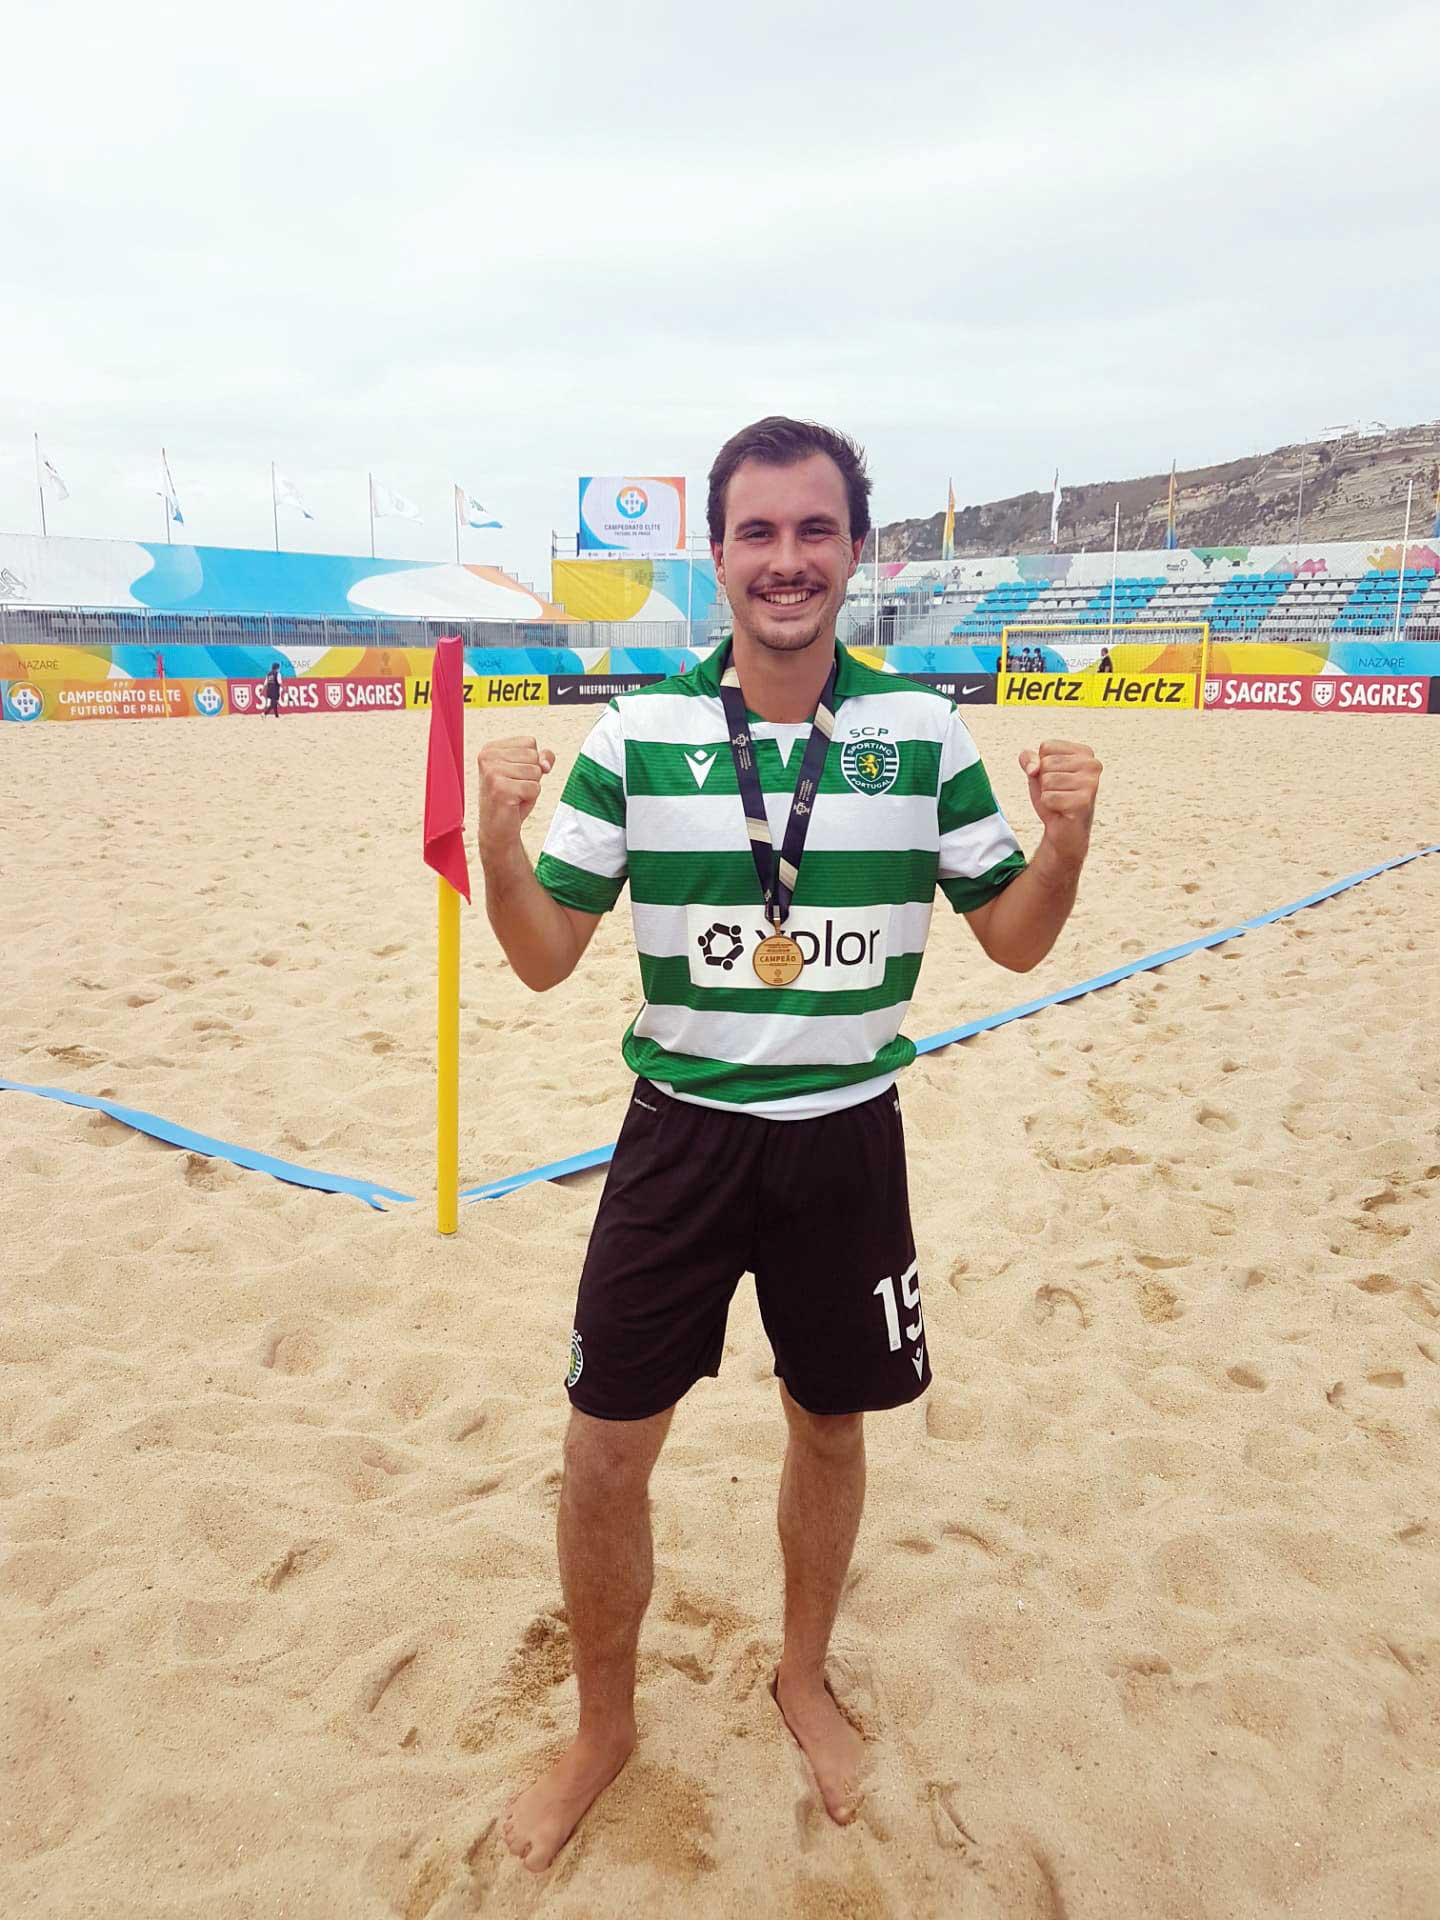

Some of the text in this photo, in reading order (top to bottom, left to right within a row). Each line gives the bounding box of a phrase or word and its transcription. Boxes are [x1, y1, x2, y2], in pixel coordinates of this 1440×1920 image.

[1358, 657, 1405, 668] NAZARÉ
[59, 689, 181, 704] CAMPEONATO ELTE
[346, 682, 402, 708] SAGRES
[487, 678, 542, 702] Hertz
[1006, 677, 1083, 701] Hertz
[1102, 677, 1185, 703] Hertz
[1224, 679, 1302, 706] SAGRES
[1338, 681, 1423, 709] SAGRES
[70, 704, 120, 715] FUTEBOL
[123, 704, 136, 714] DE
[849, 726, 889, 738] SCP
[847, 742, 893, 756] SPORTING
[851, 777, 892, 789] PORTUGAL
[759, 954, 797, 963] CAMPEÃO
[872, 1259, 923, 1352] 15
